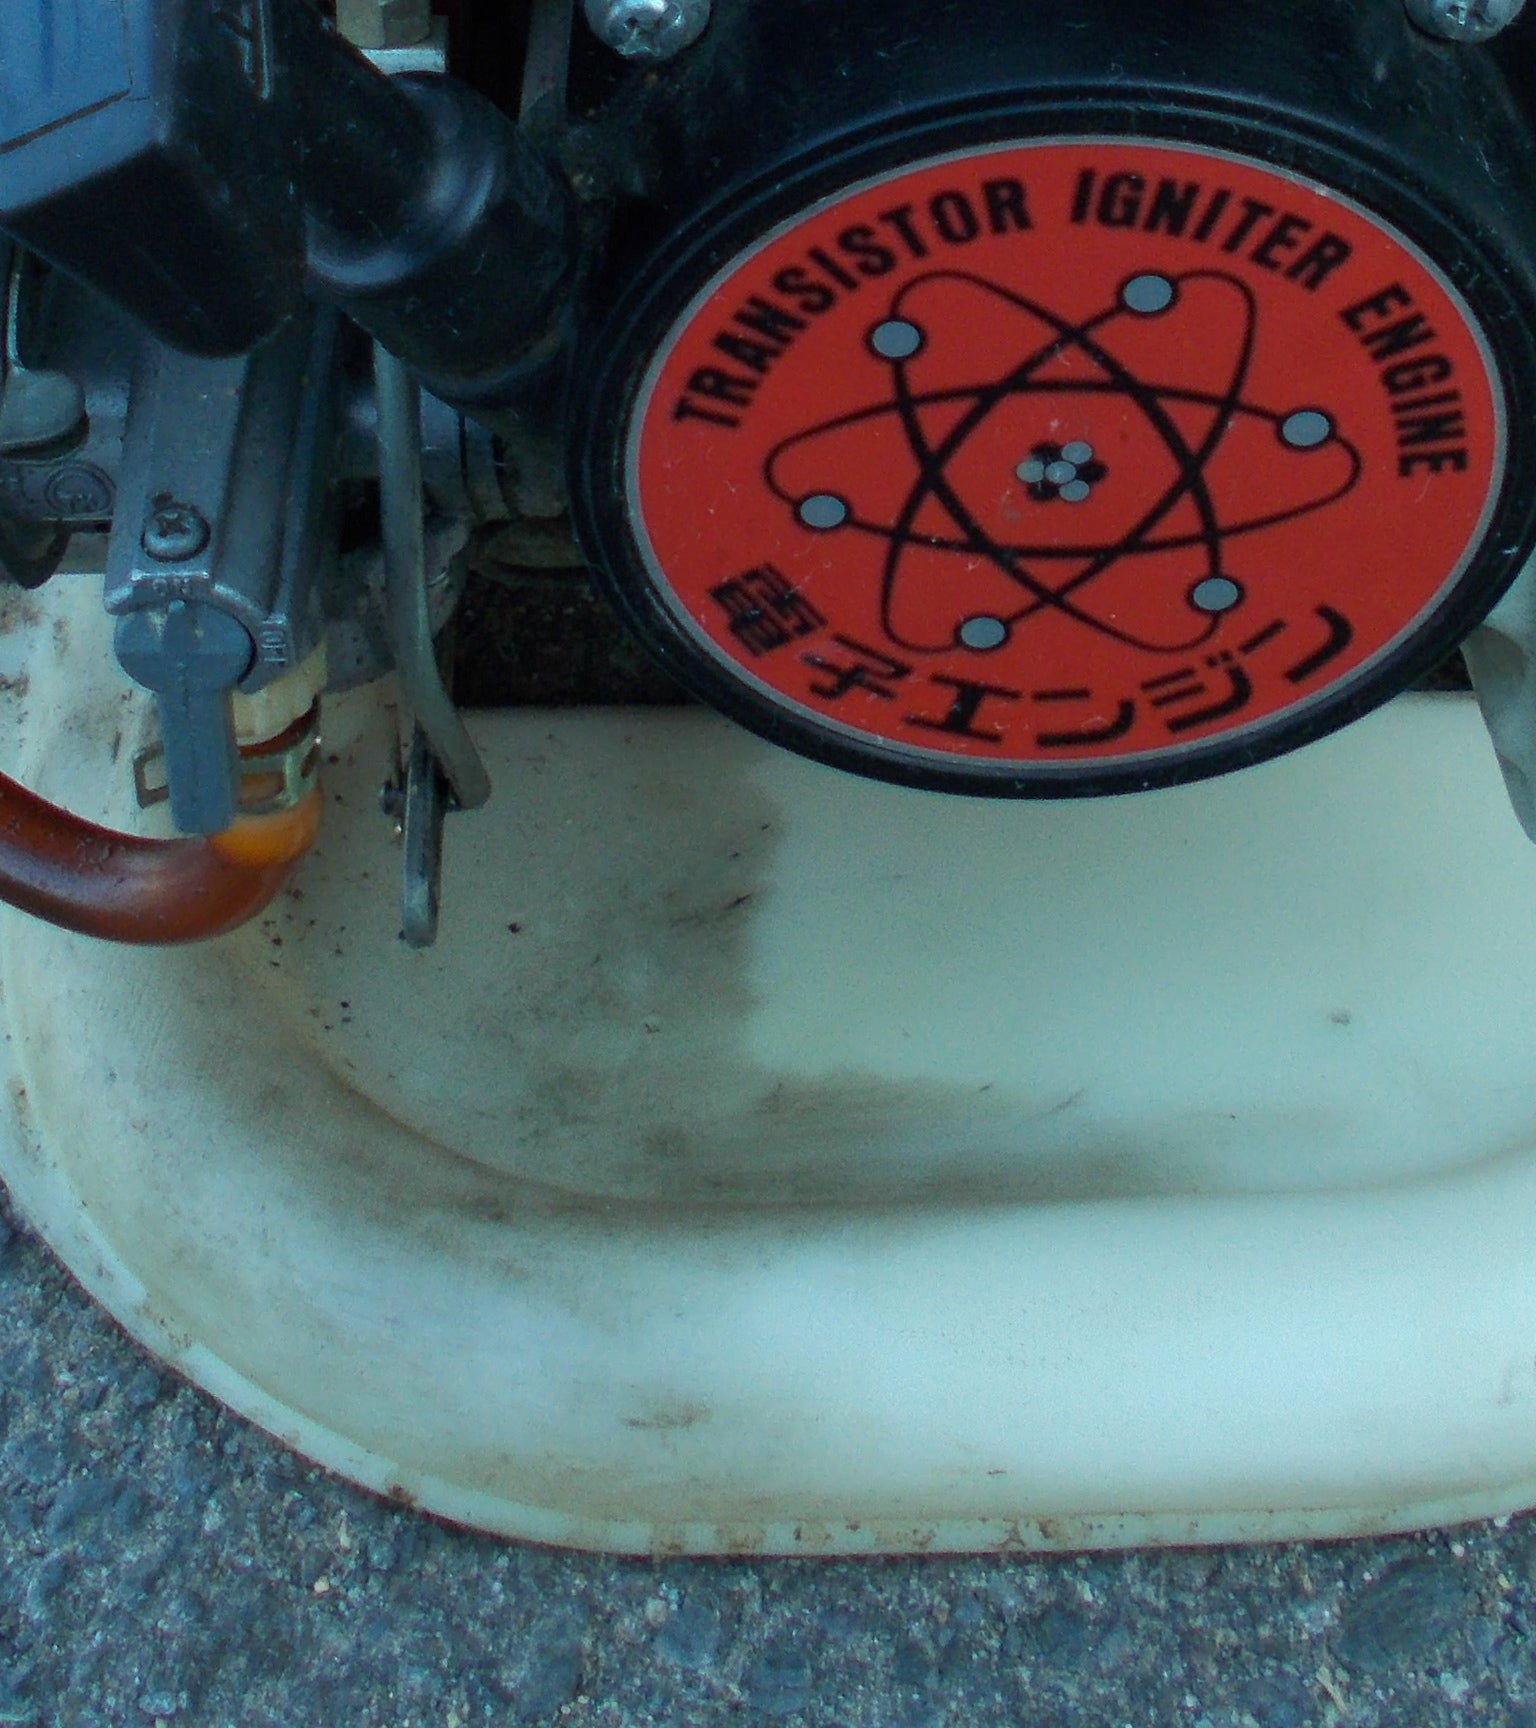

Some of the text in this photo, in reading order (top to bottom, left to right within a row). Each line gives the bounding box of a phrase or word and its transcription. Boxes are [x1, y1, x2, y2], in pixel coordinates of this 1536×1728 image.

[674, 167, 1469, 478] TRANSISTOR IGNITER ENGINE
